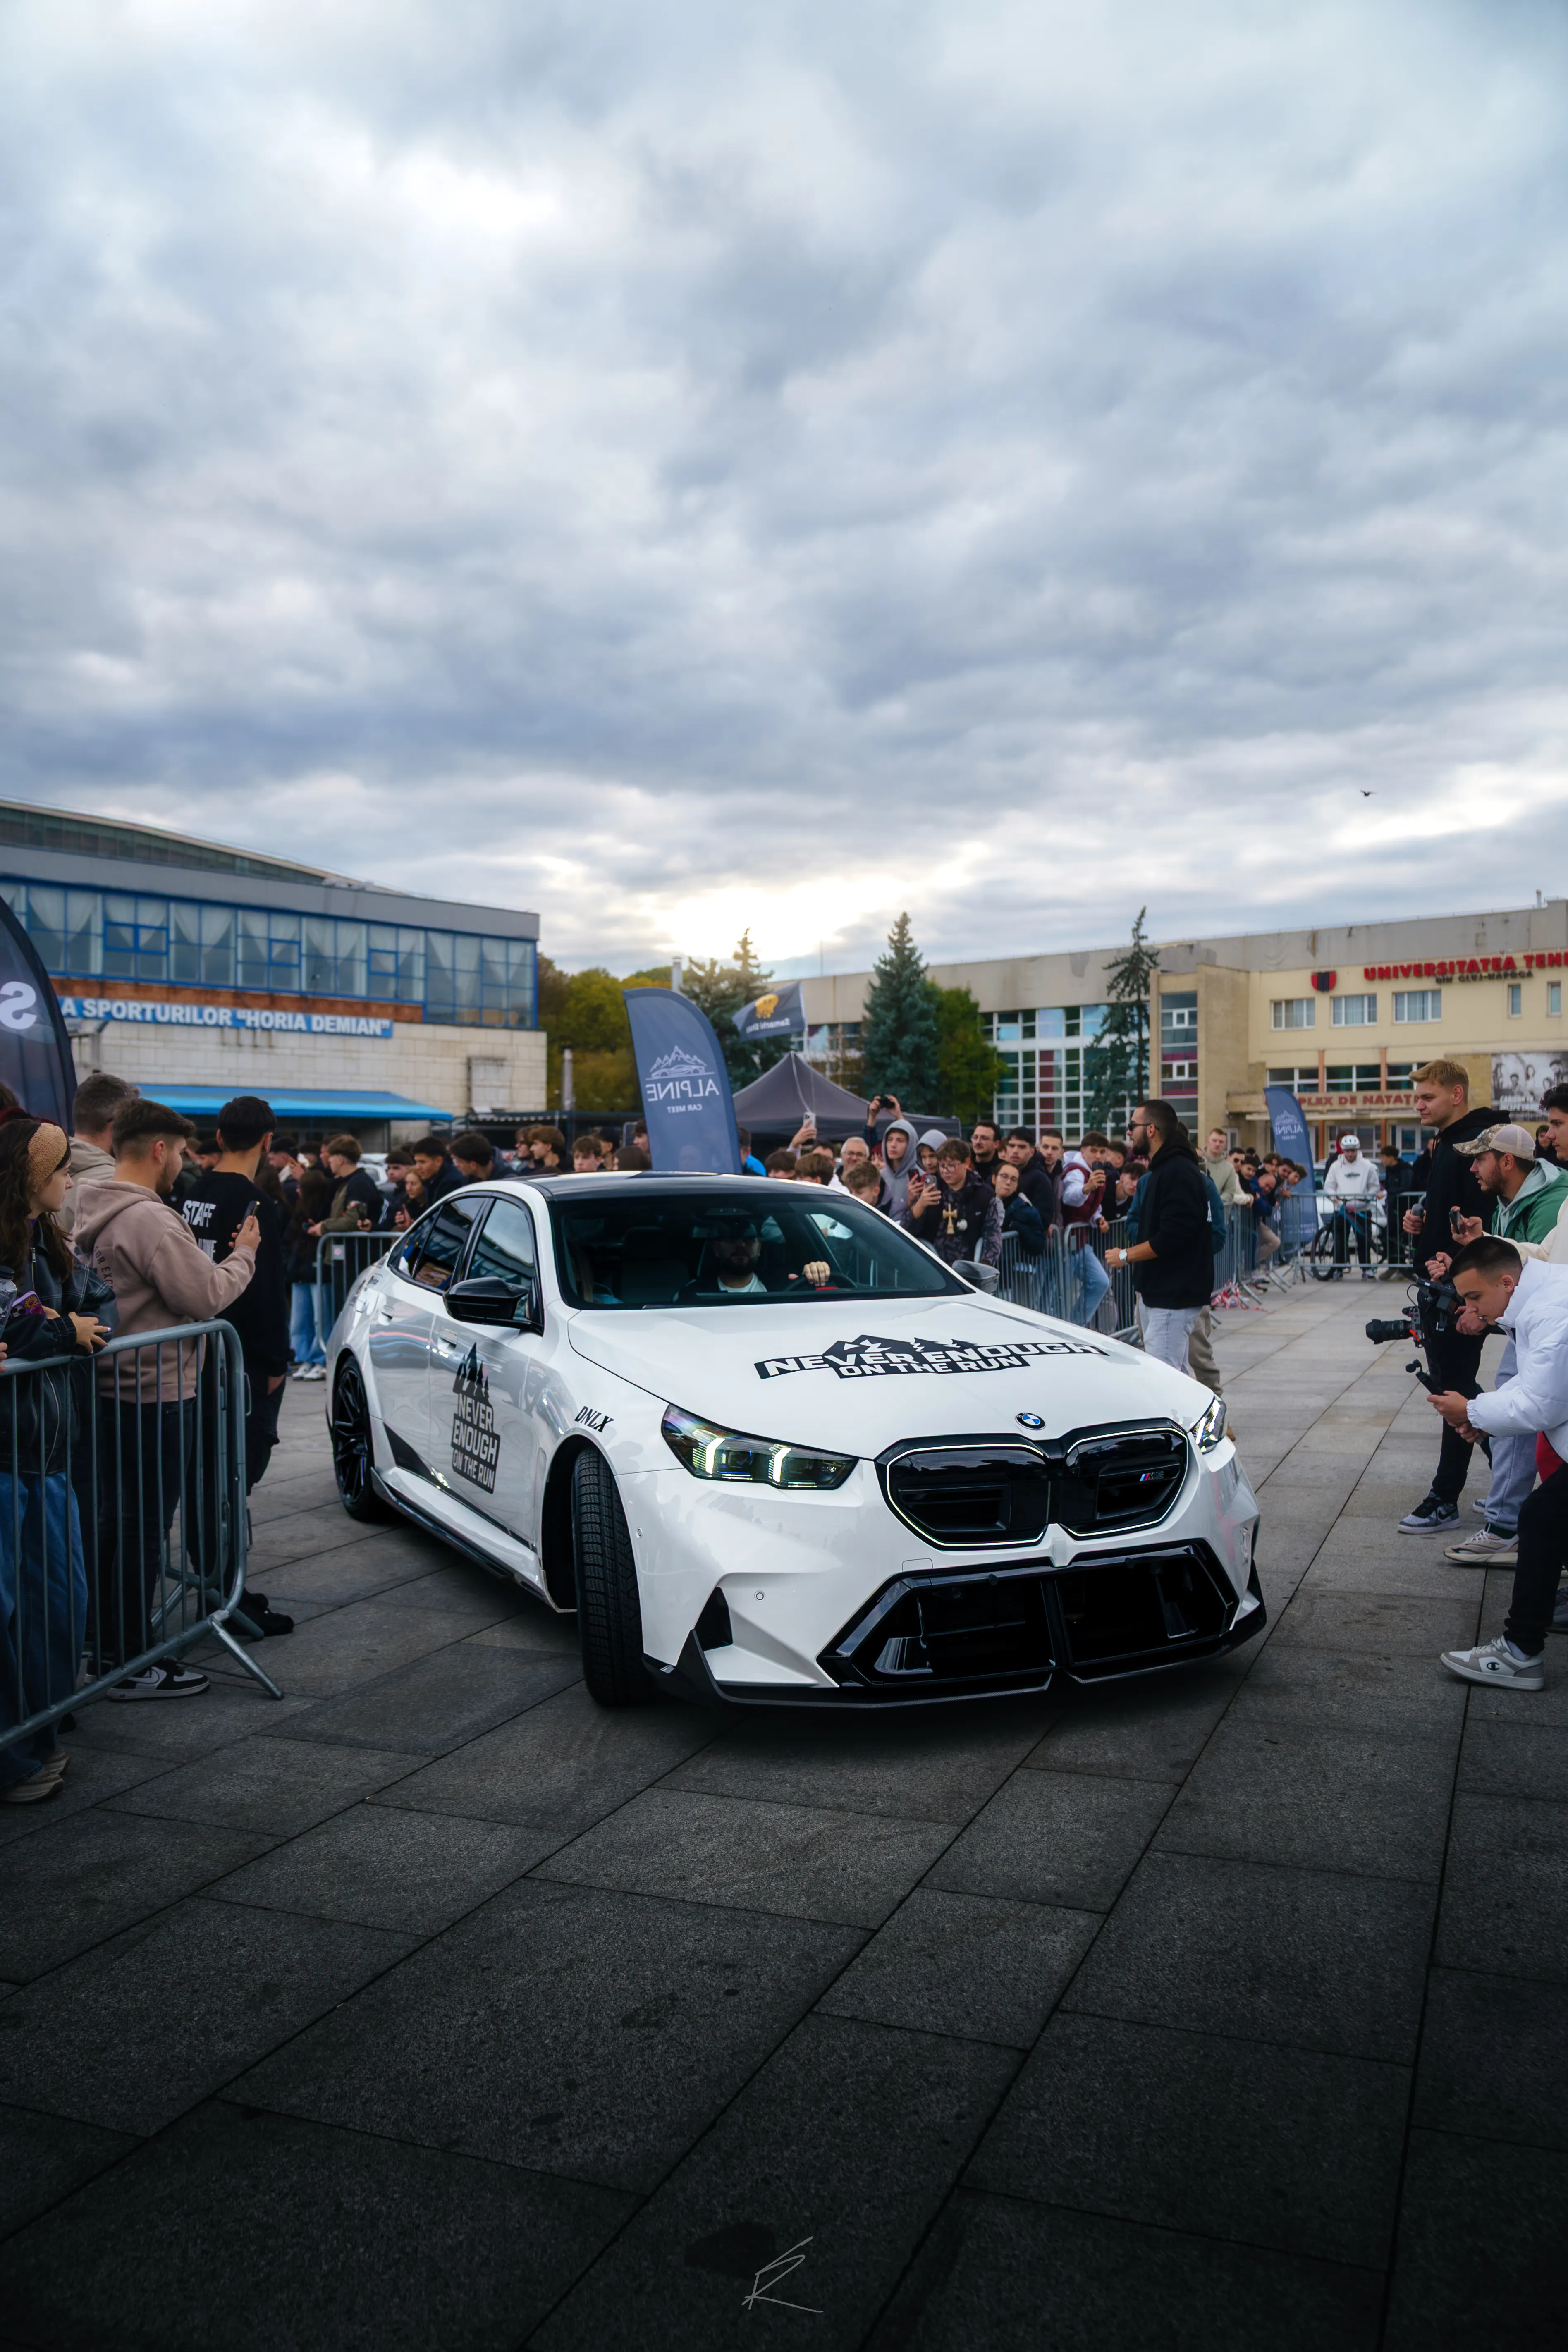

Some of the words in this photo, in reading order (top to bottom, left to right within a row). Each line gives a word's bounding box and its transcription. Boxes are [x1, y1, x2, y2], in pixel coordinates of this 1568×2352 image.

[1364, 956, 1517, 981] UNIVERSITATEA
[1436, 974, 1453, 984] DIN
[1458, 970, 1534, 982] CLUJ-NAPOCA
[83, 998, 232, 1026] SPORTURILOR
[1338, 1095, 1357, 1106] DE
[182, 1200, 217, 1228] STAFF
[764, 1353, 919, 1376] NEVER
[920, 1343, 1101, 1363] ENOUGH
[839, 1364, 886, 1376] ON
[889, 1362, 953, 1372] THE
[956, 1356, 1022, 1371] RUN
[458, 1393, 493, 1433] NEVER
[574, 1406, 614, 1433] DNLX
[452, 1419, 497, 1465] ENOUGH
[453, 1449, 464, 1470] ON
[464, 1455, 478, 1479] THE
[477, 1463, 495, 1489] RUN
